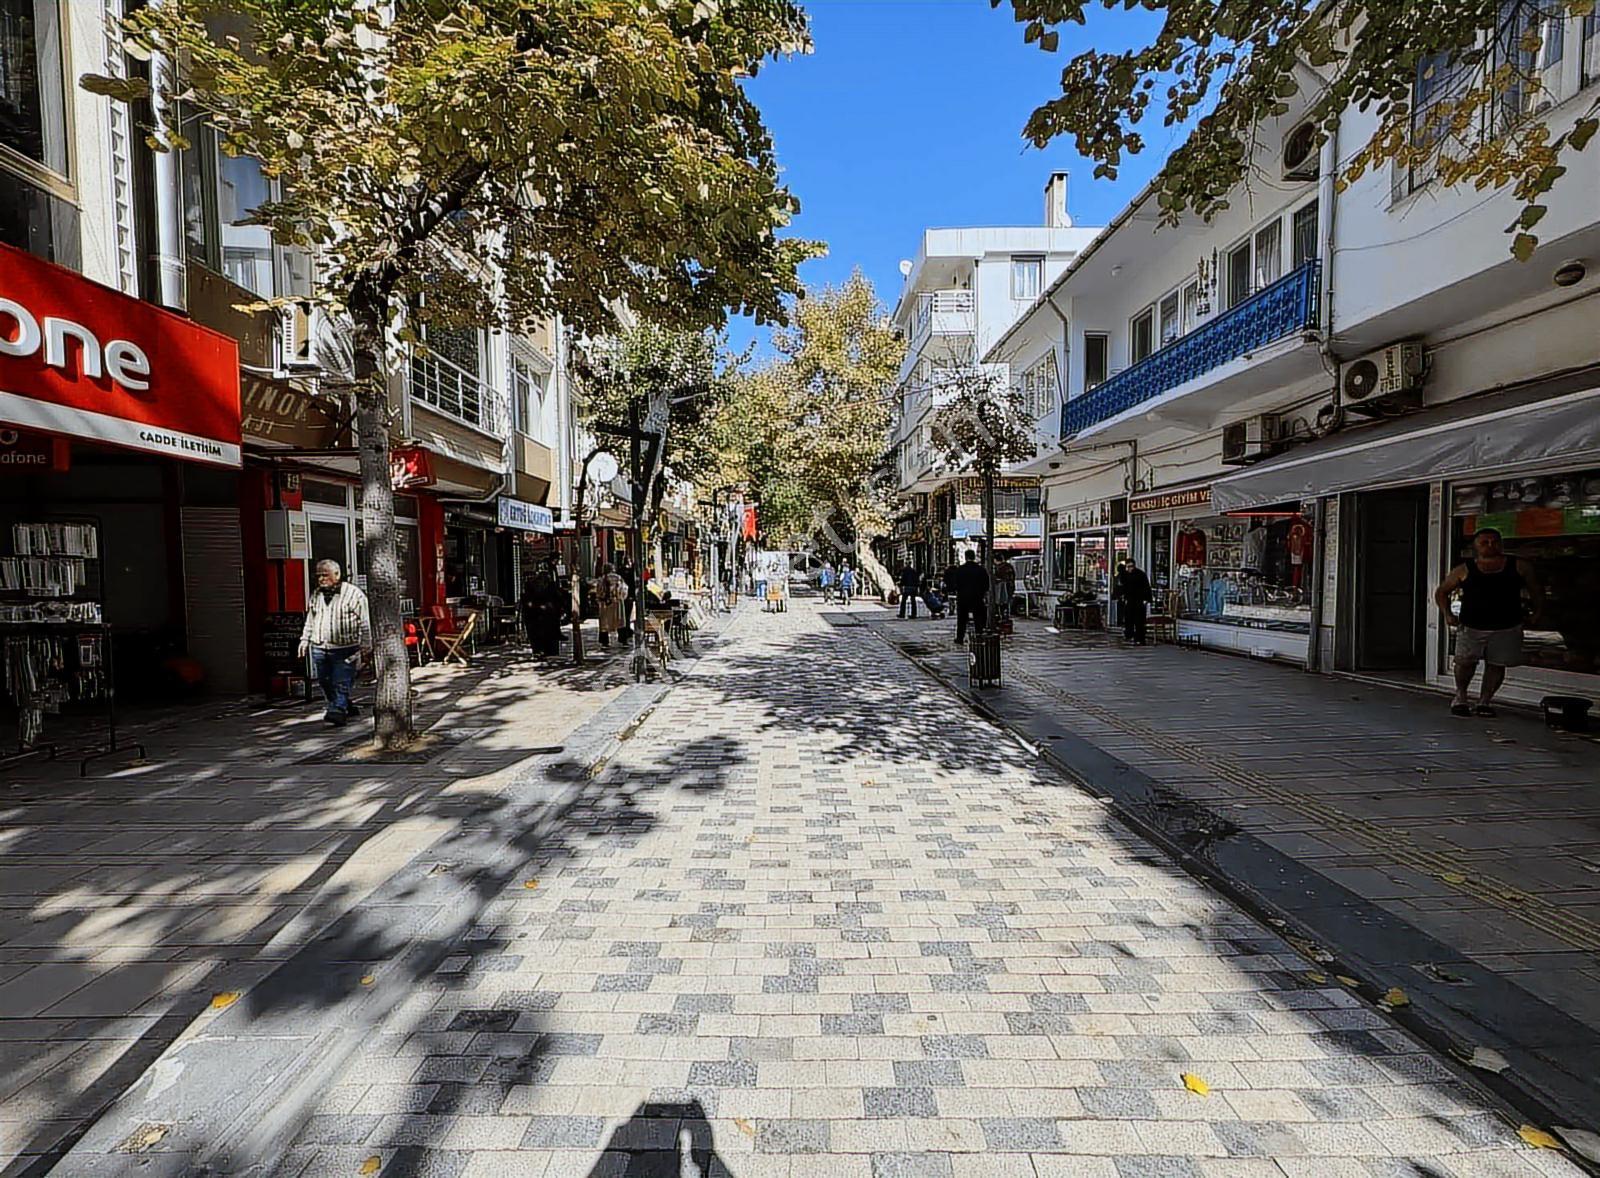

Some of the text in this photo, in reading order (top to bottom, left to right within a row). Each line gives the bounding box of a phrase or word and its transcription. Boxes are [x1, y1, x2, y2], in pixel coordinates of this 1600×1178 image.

[140, 431, 177, 447] CADDE
[1131, 500, 1157, 511] CANSU
[1171, 491, 1198, 505] GİYİM
